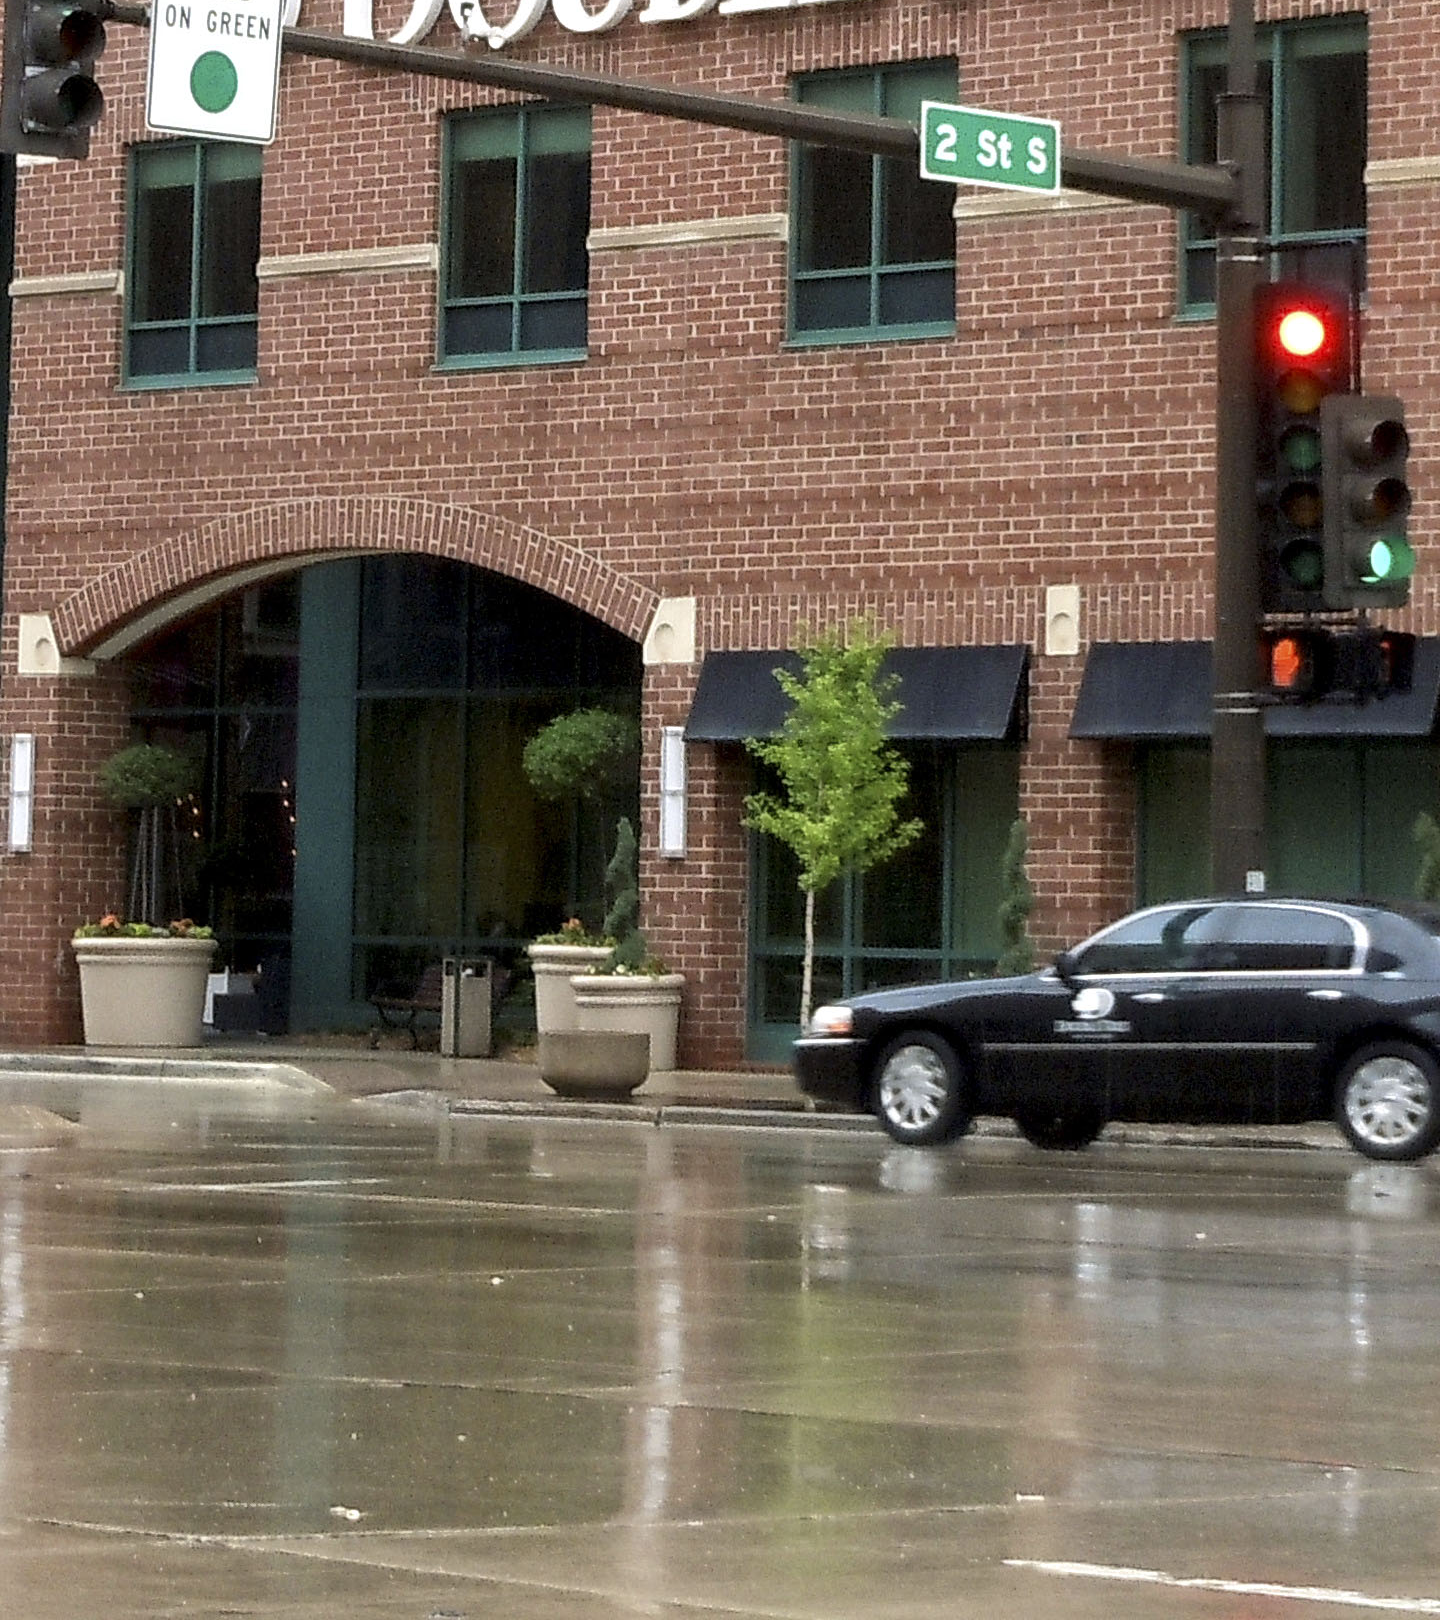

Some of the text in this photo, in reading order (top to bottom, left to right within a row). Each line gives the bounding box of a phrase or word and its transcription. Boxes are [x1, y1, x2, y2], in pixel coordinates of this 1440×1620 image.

[165, 4, 270, 40] ON GREEN
[934, 123, 1047, 174] 2 St S
